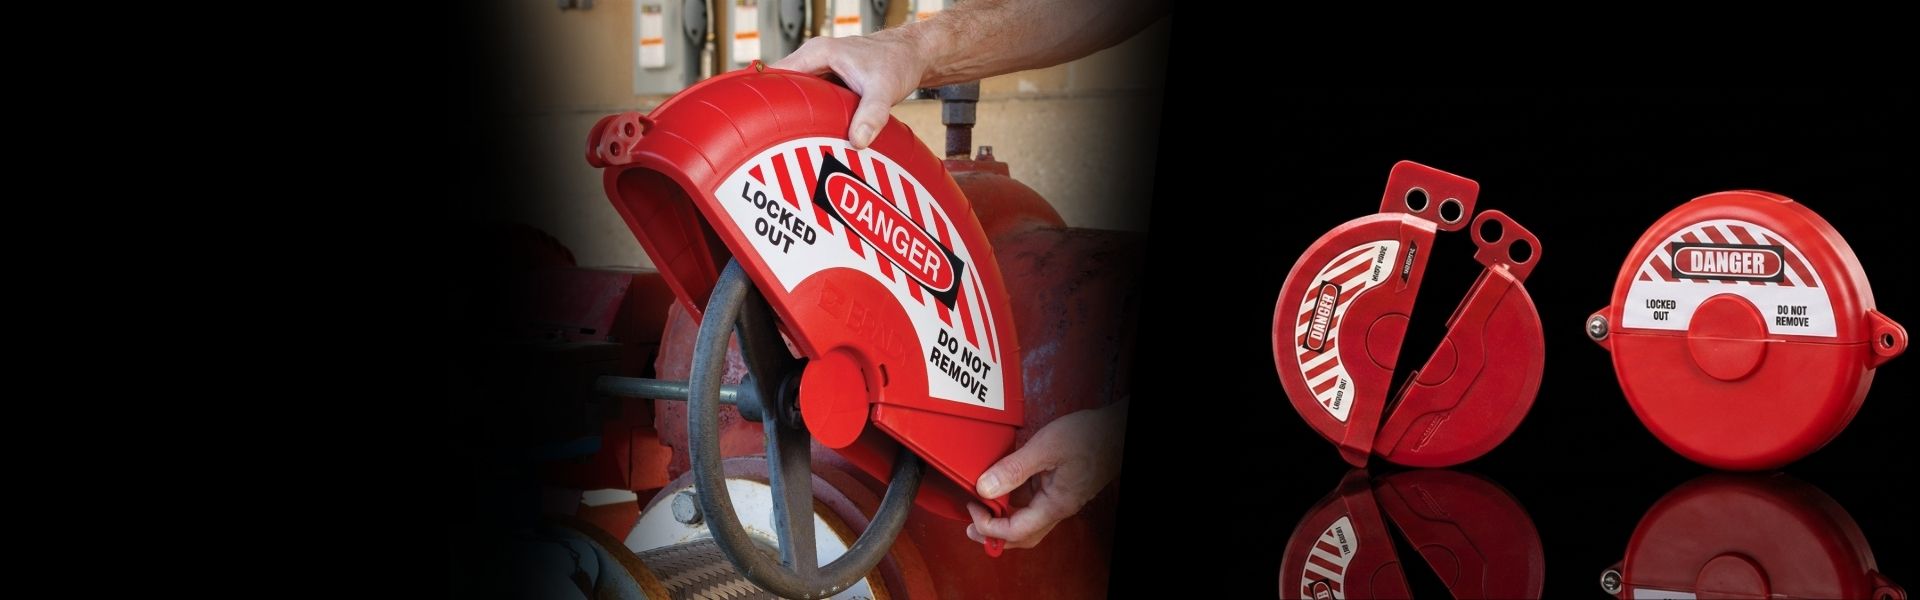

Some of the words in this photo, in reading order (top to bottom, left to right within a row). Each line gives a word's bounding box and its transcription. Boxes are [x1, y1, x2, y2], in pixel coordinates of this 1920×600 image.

[741, 181, 817, 246] LOCKED
[755, 217, 795, 254] OUT
[840, 183, 941, 283] DANGER
[1690, 250, 1765, 275] DANGER
[1646, 299, 1676, 310] LOCKED
[1653, 311, 1670, 321] OUT
[1777, 305, 1789, 315] DO
[1790, 305, 1808, 316] NOT
[1775, 316, 1809, 327] REMOVE
[937, 327, 959, 355] DO
[960, 346, 992, 380] NOT
[929, 346, 989, 403] REMOVE
